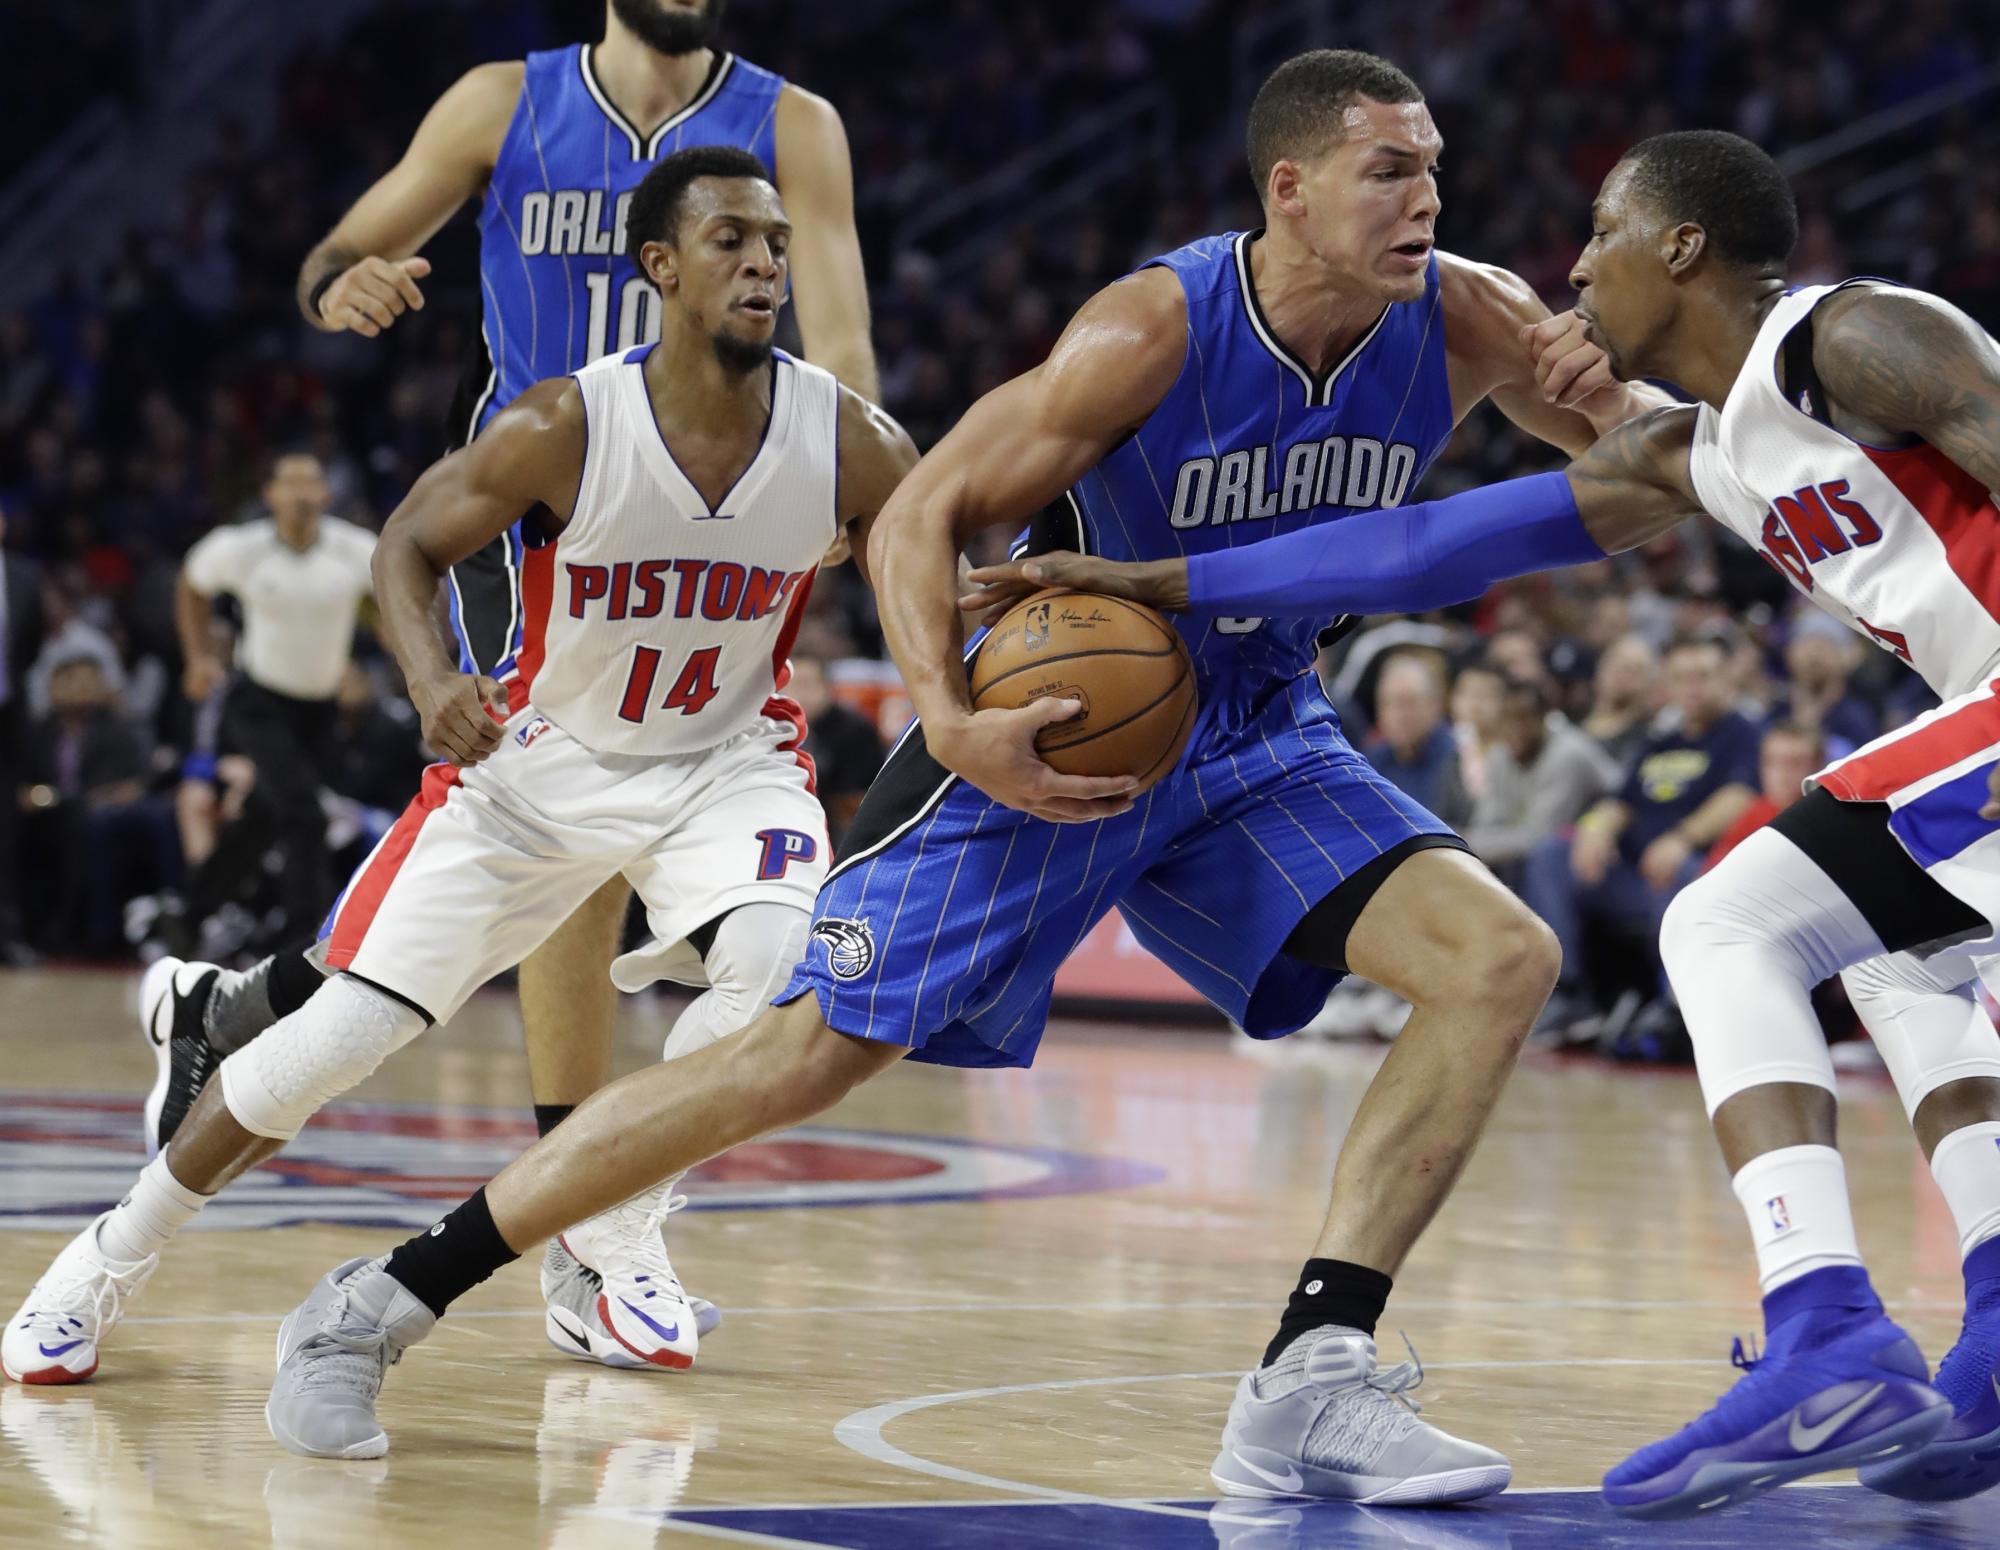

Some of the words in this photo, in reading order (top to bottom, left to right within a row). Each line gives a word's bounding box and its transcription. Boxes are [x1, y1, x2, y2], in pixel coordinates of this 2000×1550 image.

[586, 272, 663, 366] 10
[1170, 436, 1416, 529] ORLANDO
[566, 558, 806, 621] PISTONS
[618, 645, 723, 724] 14
